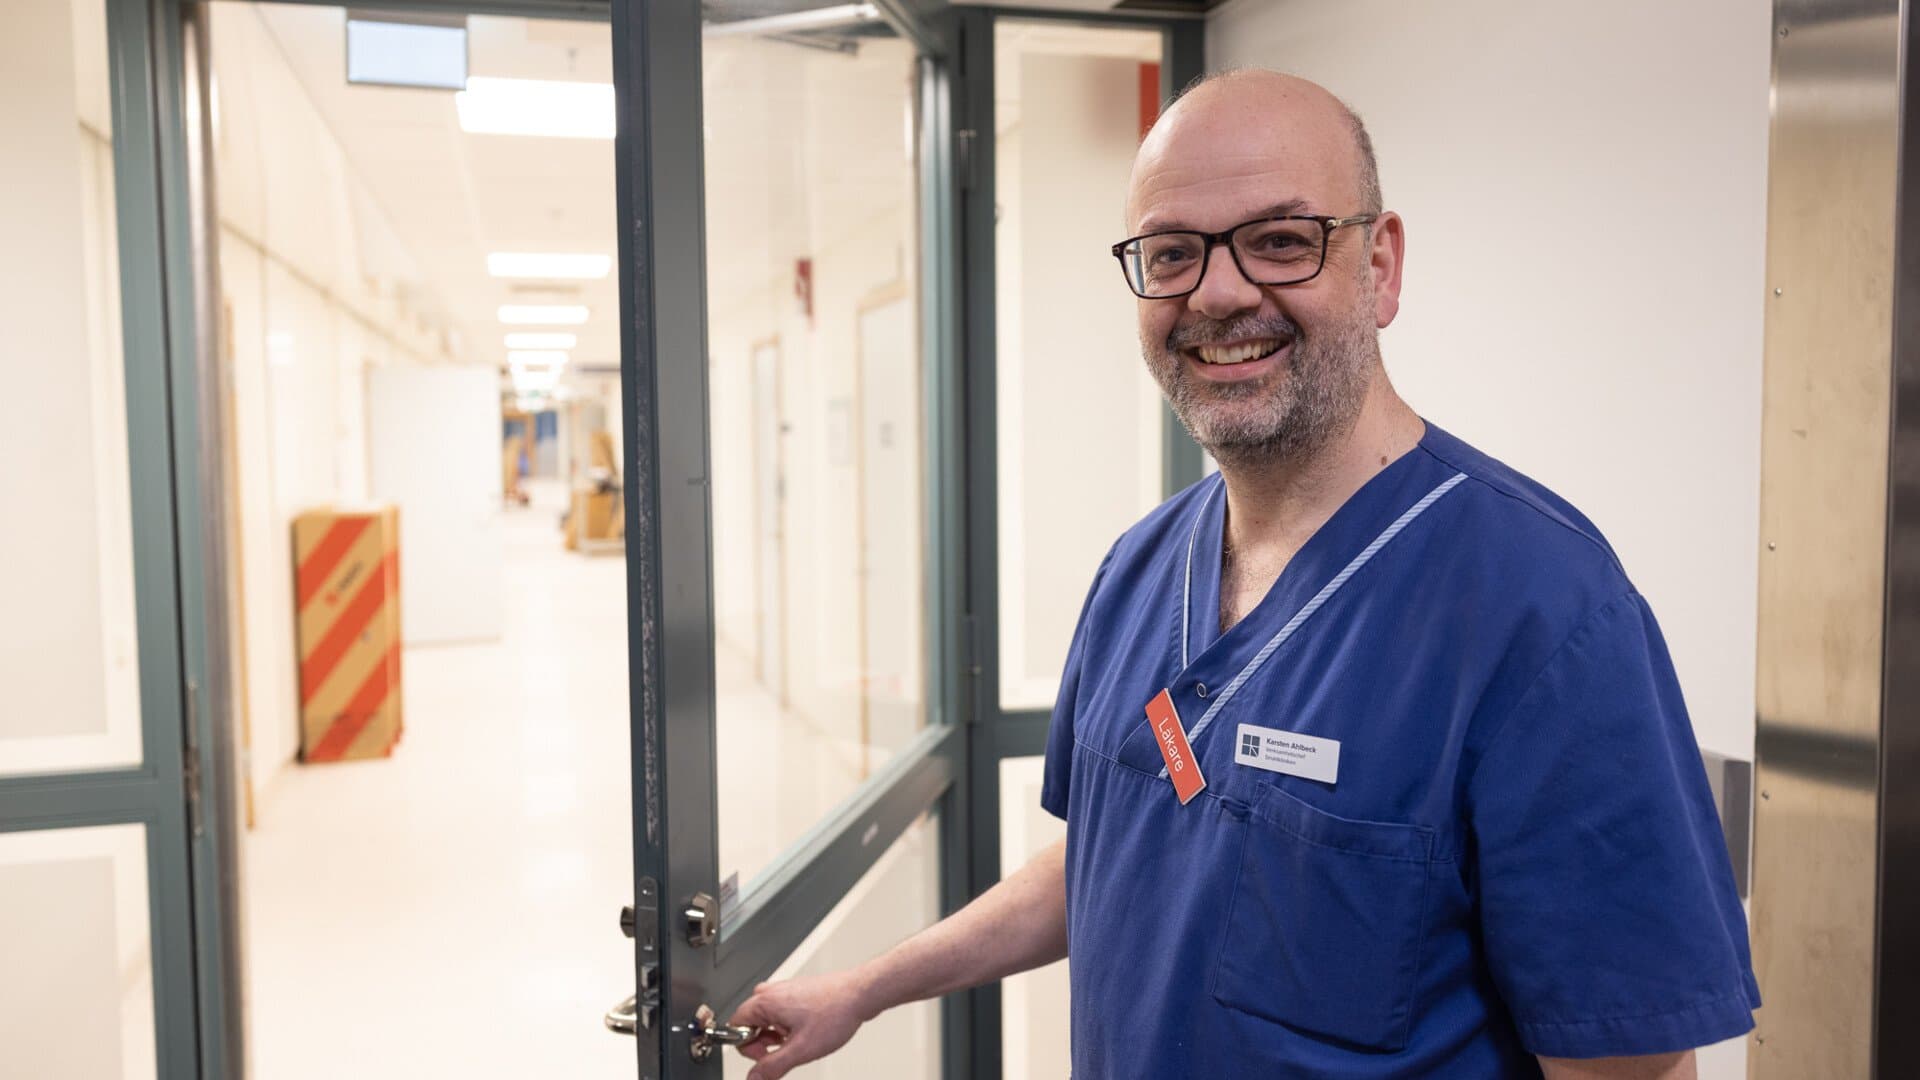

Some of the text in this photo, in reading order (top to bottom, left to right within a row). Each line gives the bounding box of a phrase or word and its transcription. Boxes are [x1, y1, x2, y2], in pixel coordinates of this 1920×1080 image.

[1158, 717, 1184, 772] Läkare
[1266, 737, 1316, 753] Karsten Ahlbeck
